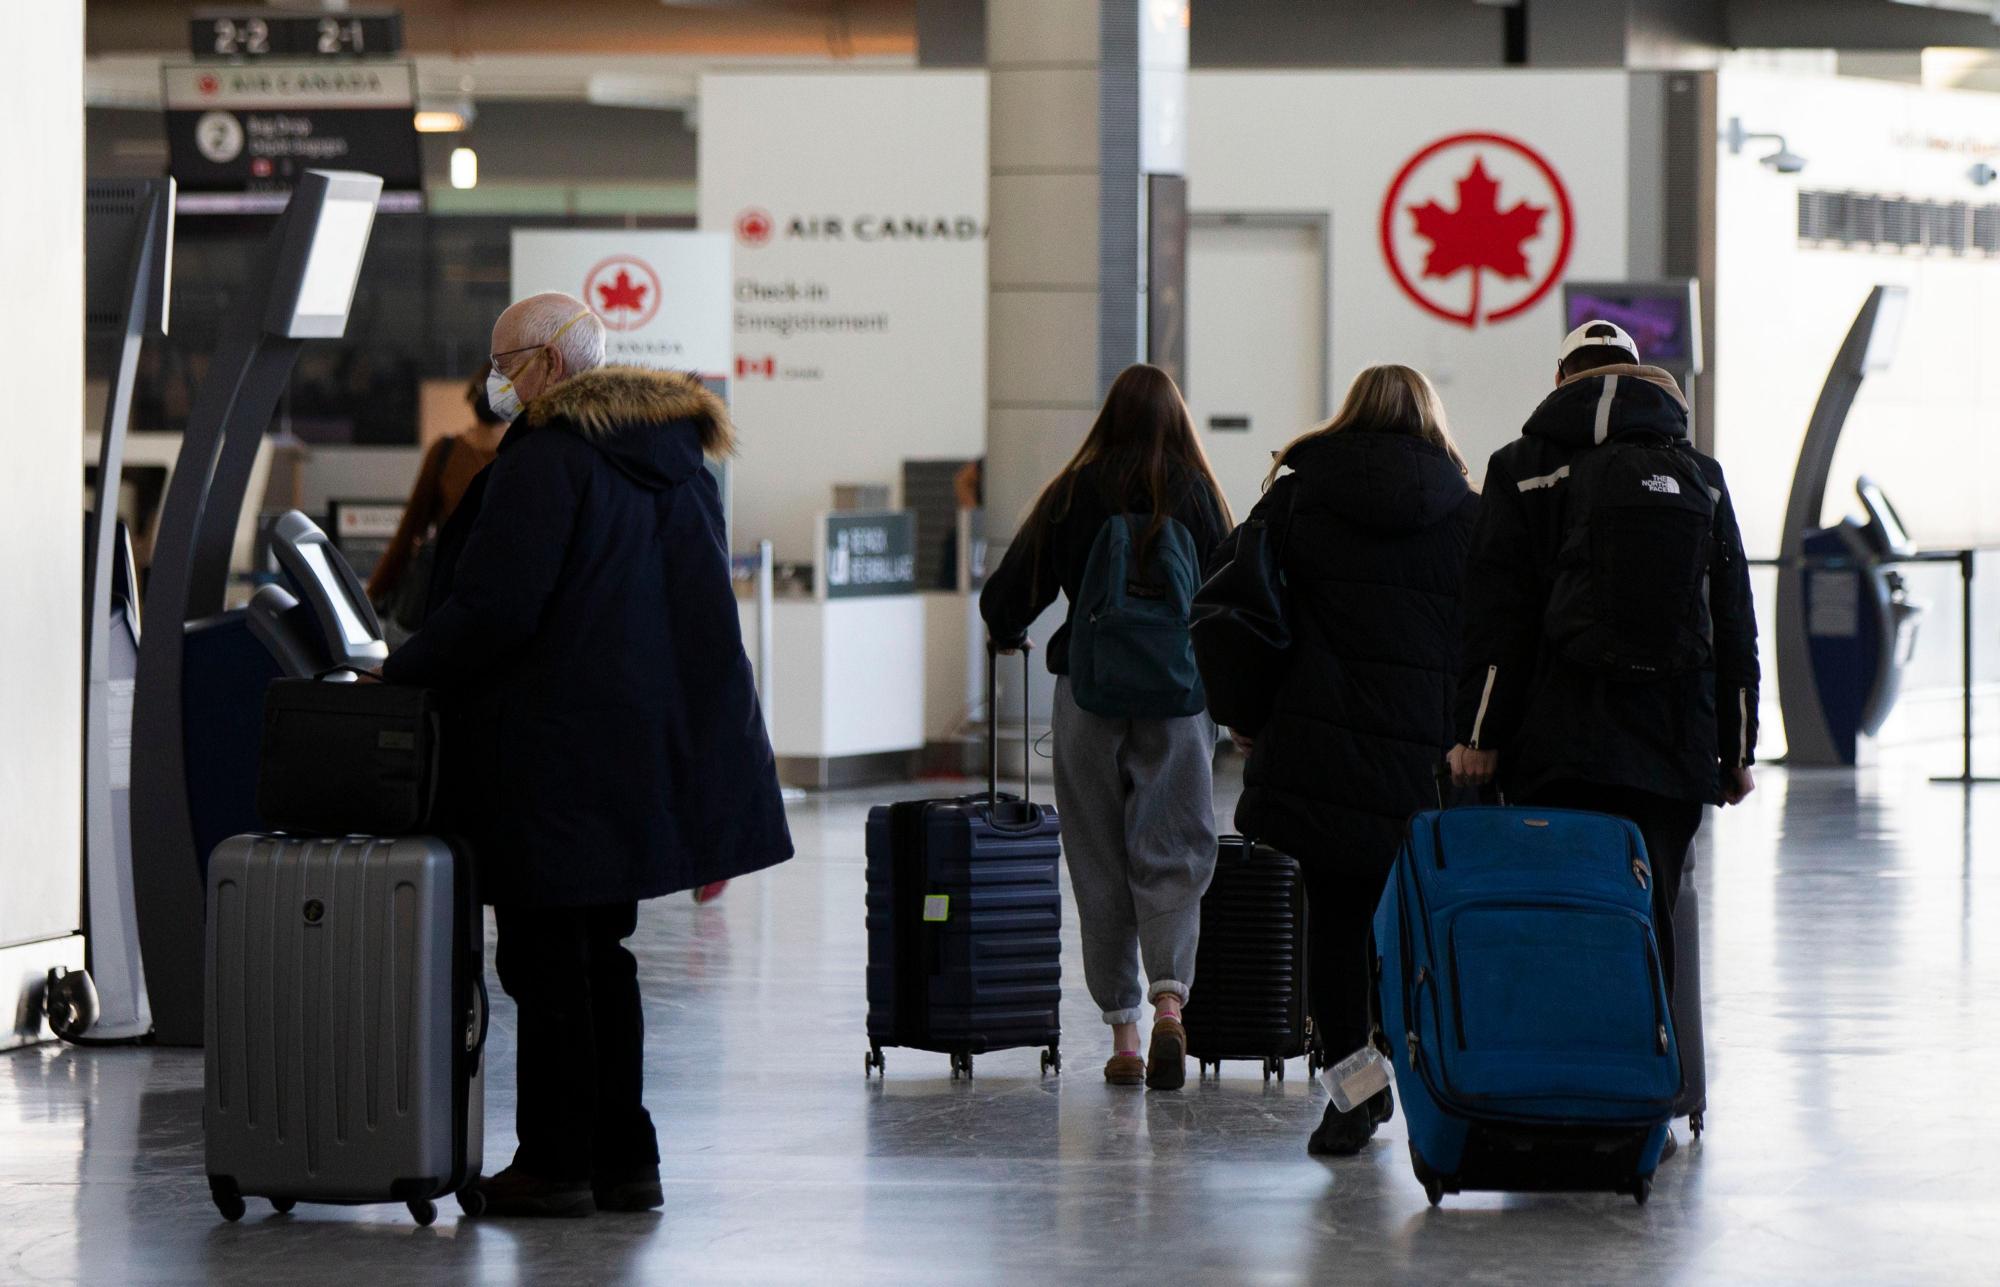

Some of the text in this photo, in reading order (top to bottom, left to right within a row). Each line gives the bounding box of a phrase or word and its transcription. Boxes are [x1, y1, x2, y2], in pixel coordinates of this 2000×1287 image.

[214, 17, 364, 53] 2-2 2-1
[231, 71, 381, 92] AIR CANADA
[785, 214, 988, 241] AIR CANAD
[1652, 474, 1668, 482] THE
